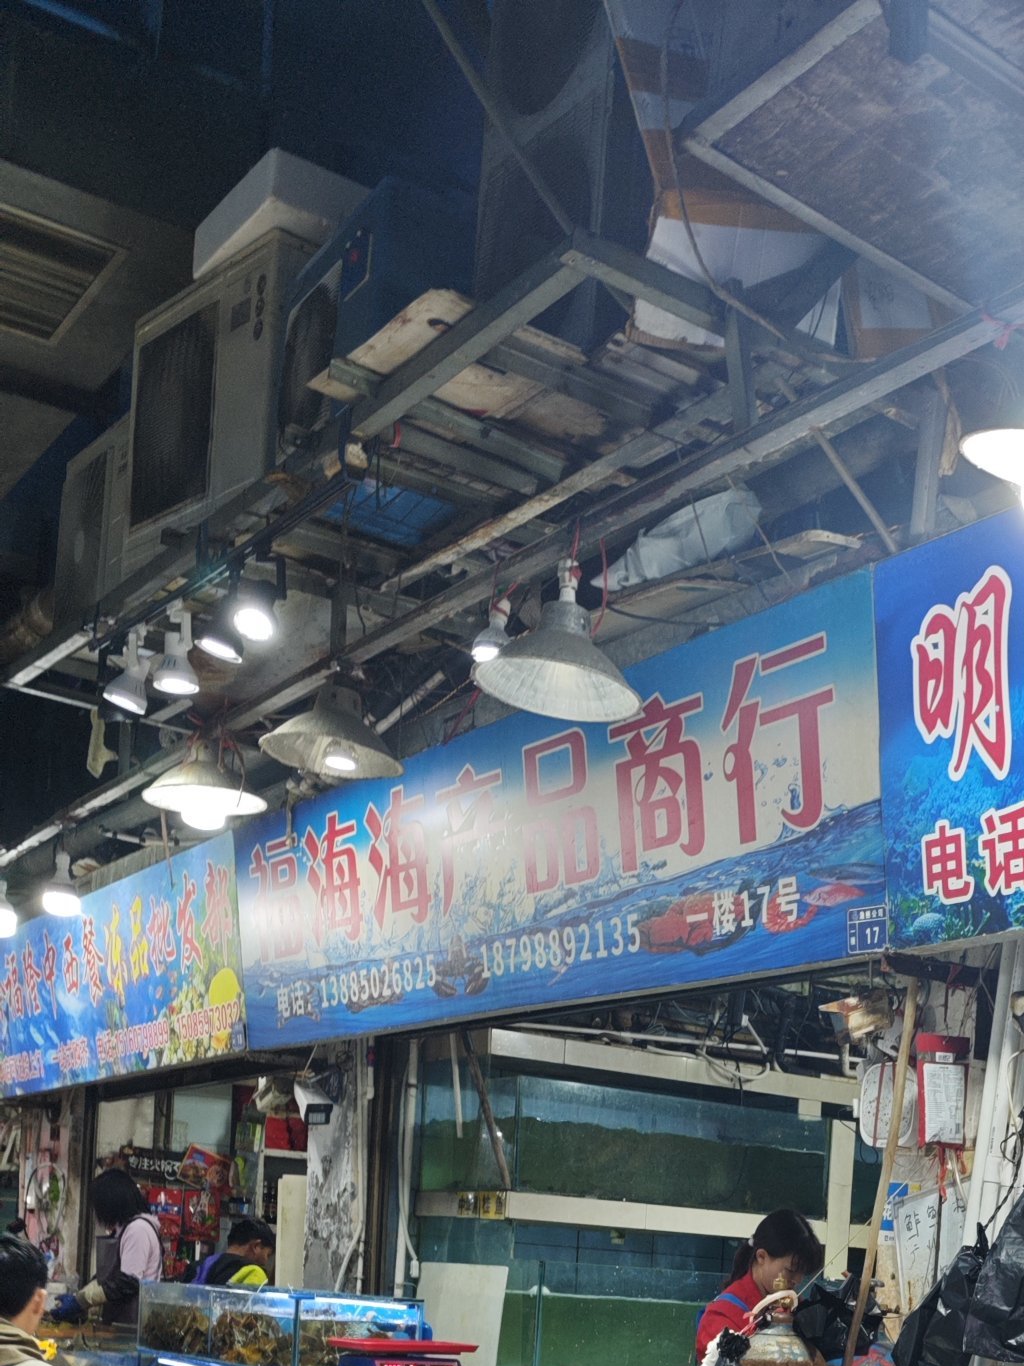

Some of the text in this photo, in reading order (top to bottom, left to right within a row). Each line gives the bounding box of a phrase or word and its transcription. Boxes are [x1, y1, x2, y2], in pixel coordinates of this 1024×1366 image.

[250, 630, 838, 965] 福海海产品商行
[319, 955, 438, 1009] 13885026825
[479, 912, 642, 979] 18798892135
[685, 875, 801, 938] 一楼17号
[865, 926, 880, 945] 17
